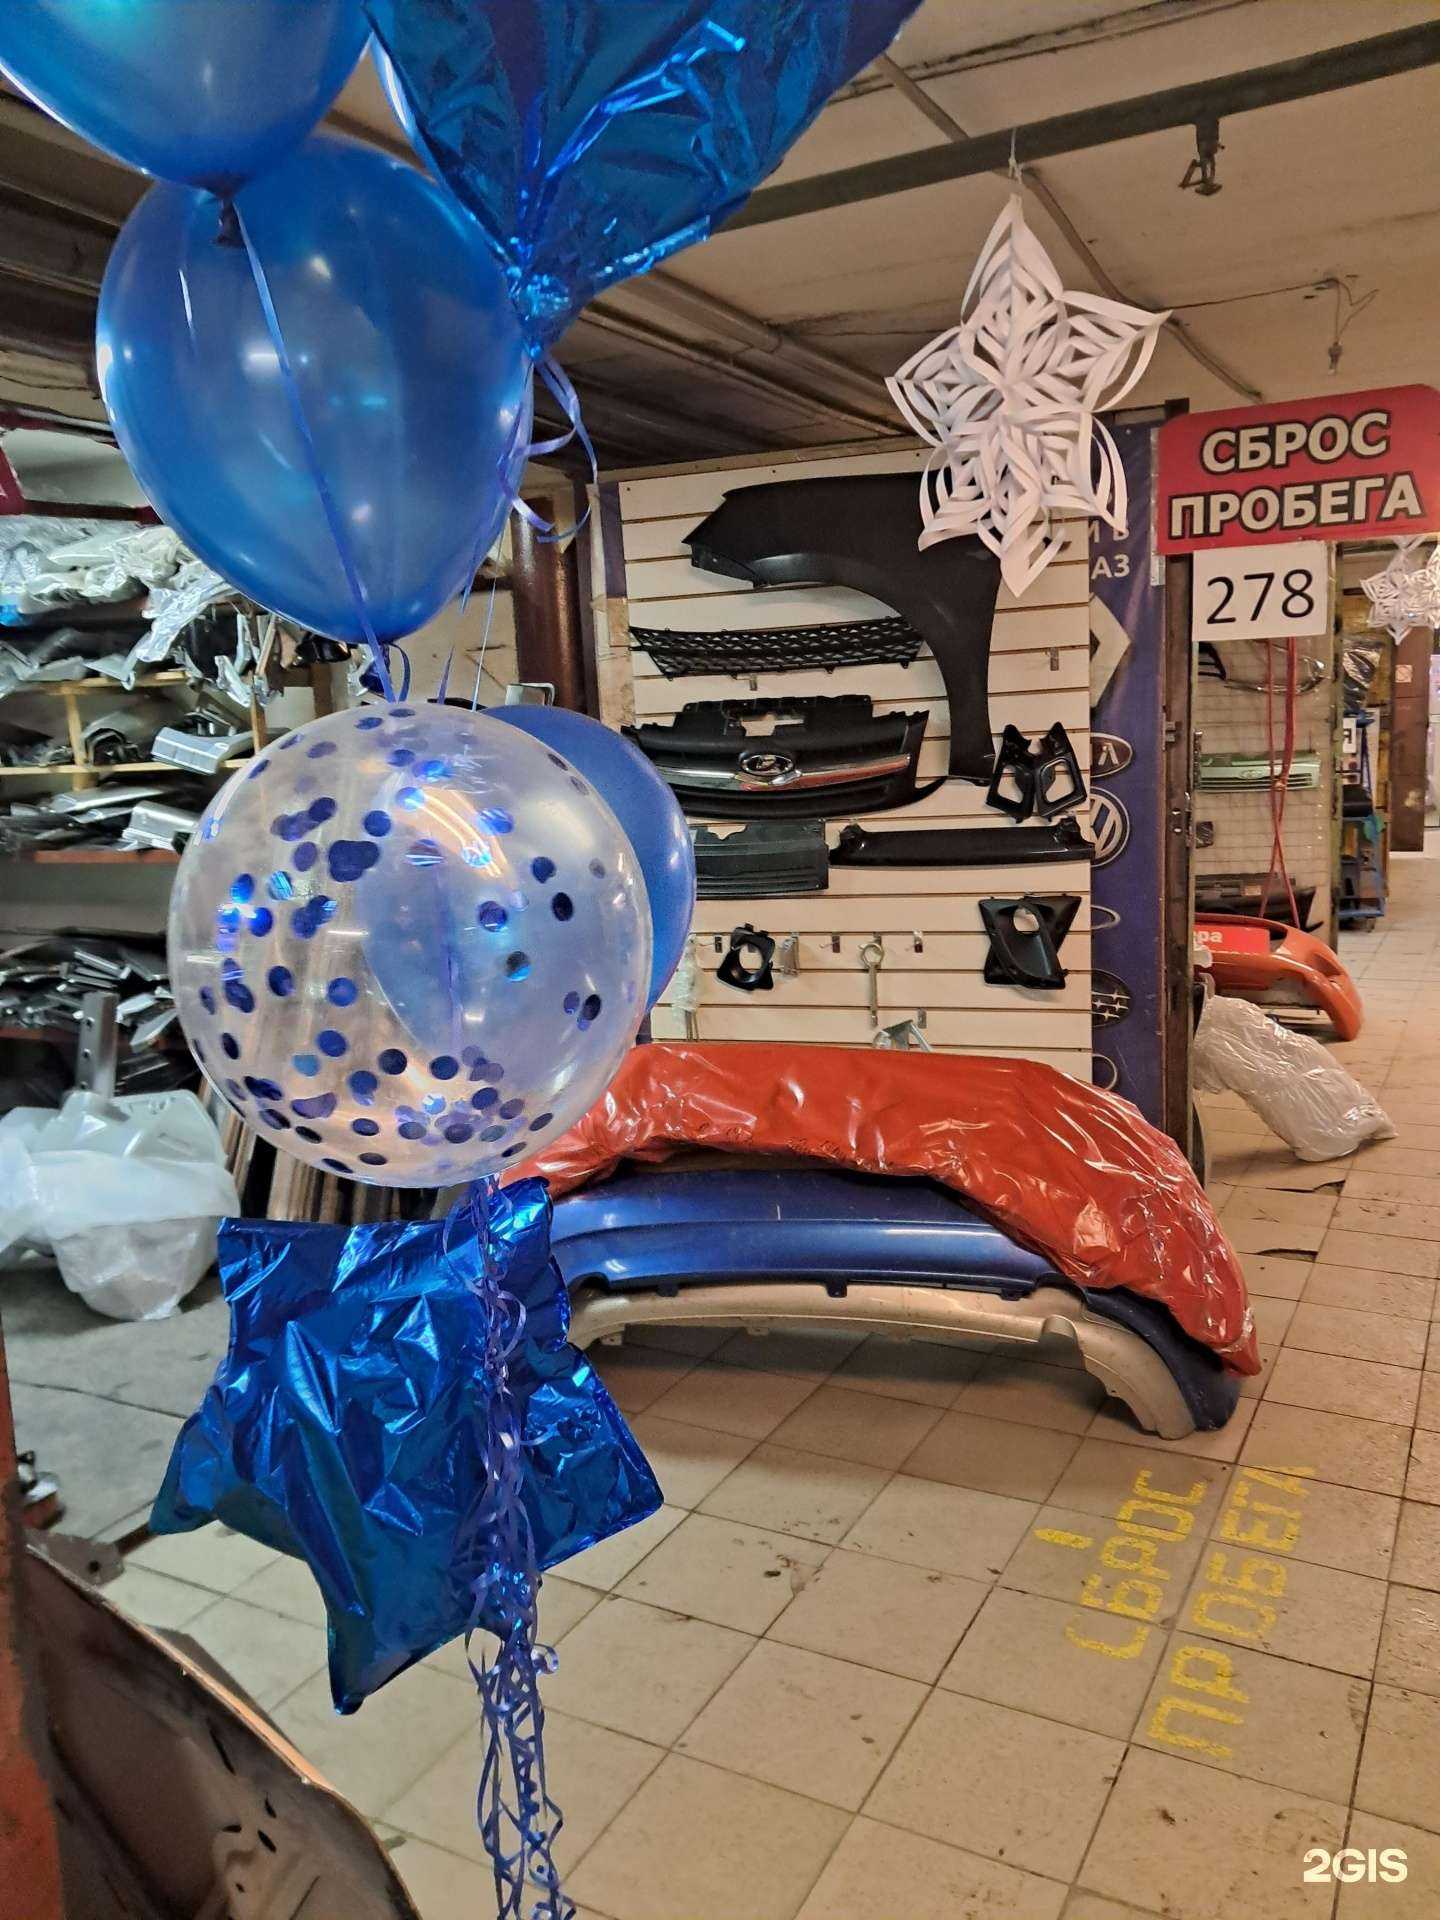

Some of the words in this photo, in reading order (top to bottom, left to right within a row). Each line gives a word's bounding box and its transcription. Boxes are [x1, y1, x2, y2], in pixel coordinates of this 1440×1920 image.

[1202, 411, 1390, 474] СБРОС
[1169, 473, 1424, 540] ПРОБЕГА
[1206, 568, 1315, 625] 278
[1064, 1468, 1207, 1660] СБРОС
[1145, 1465, 1317, 1758] ПРОБЕГА
